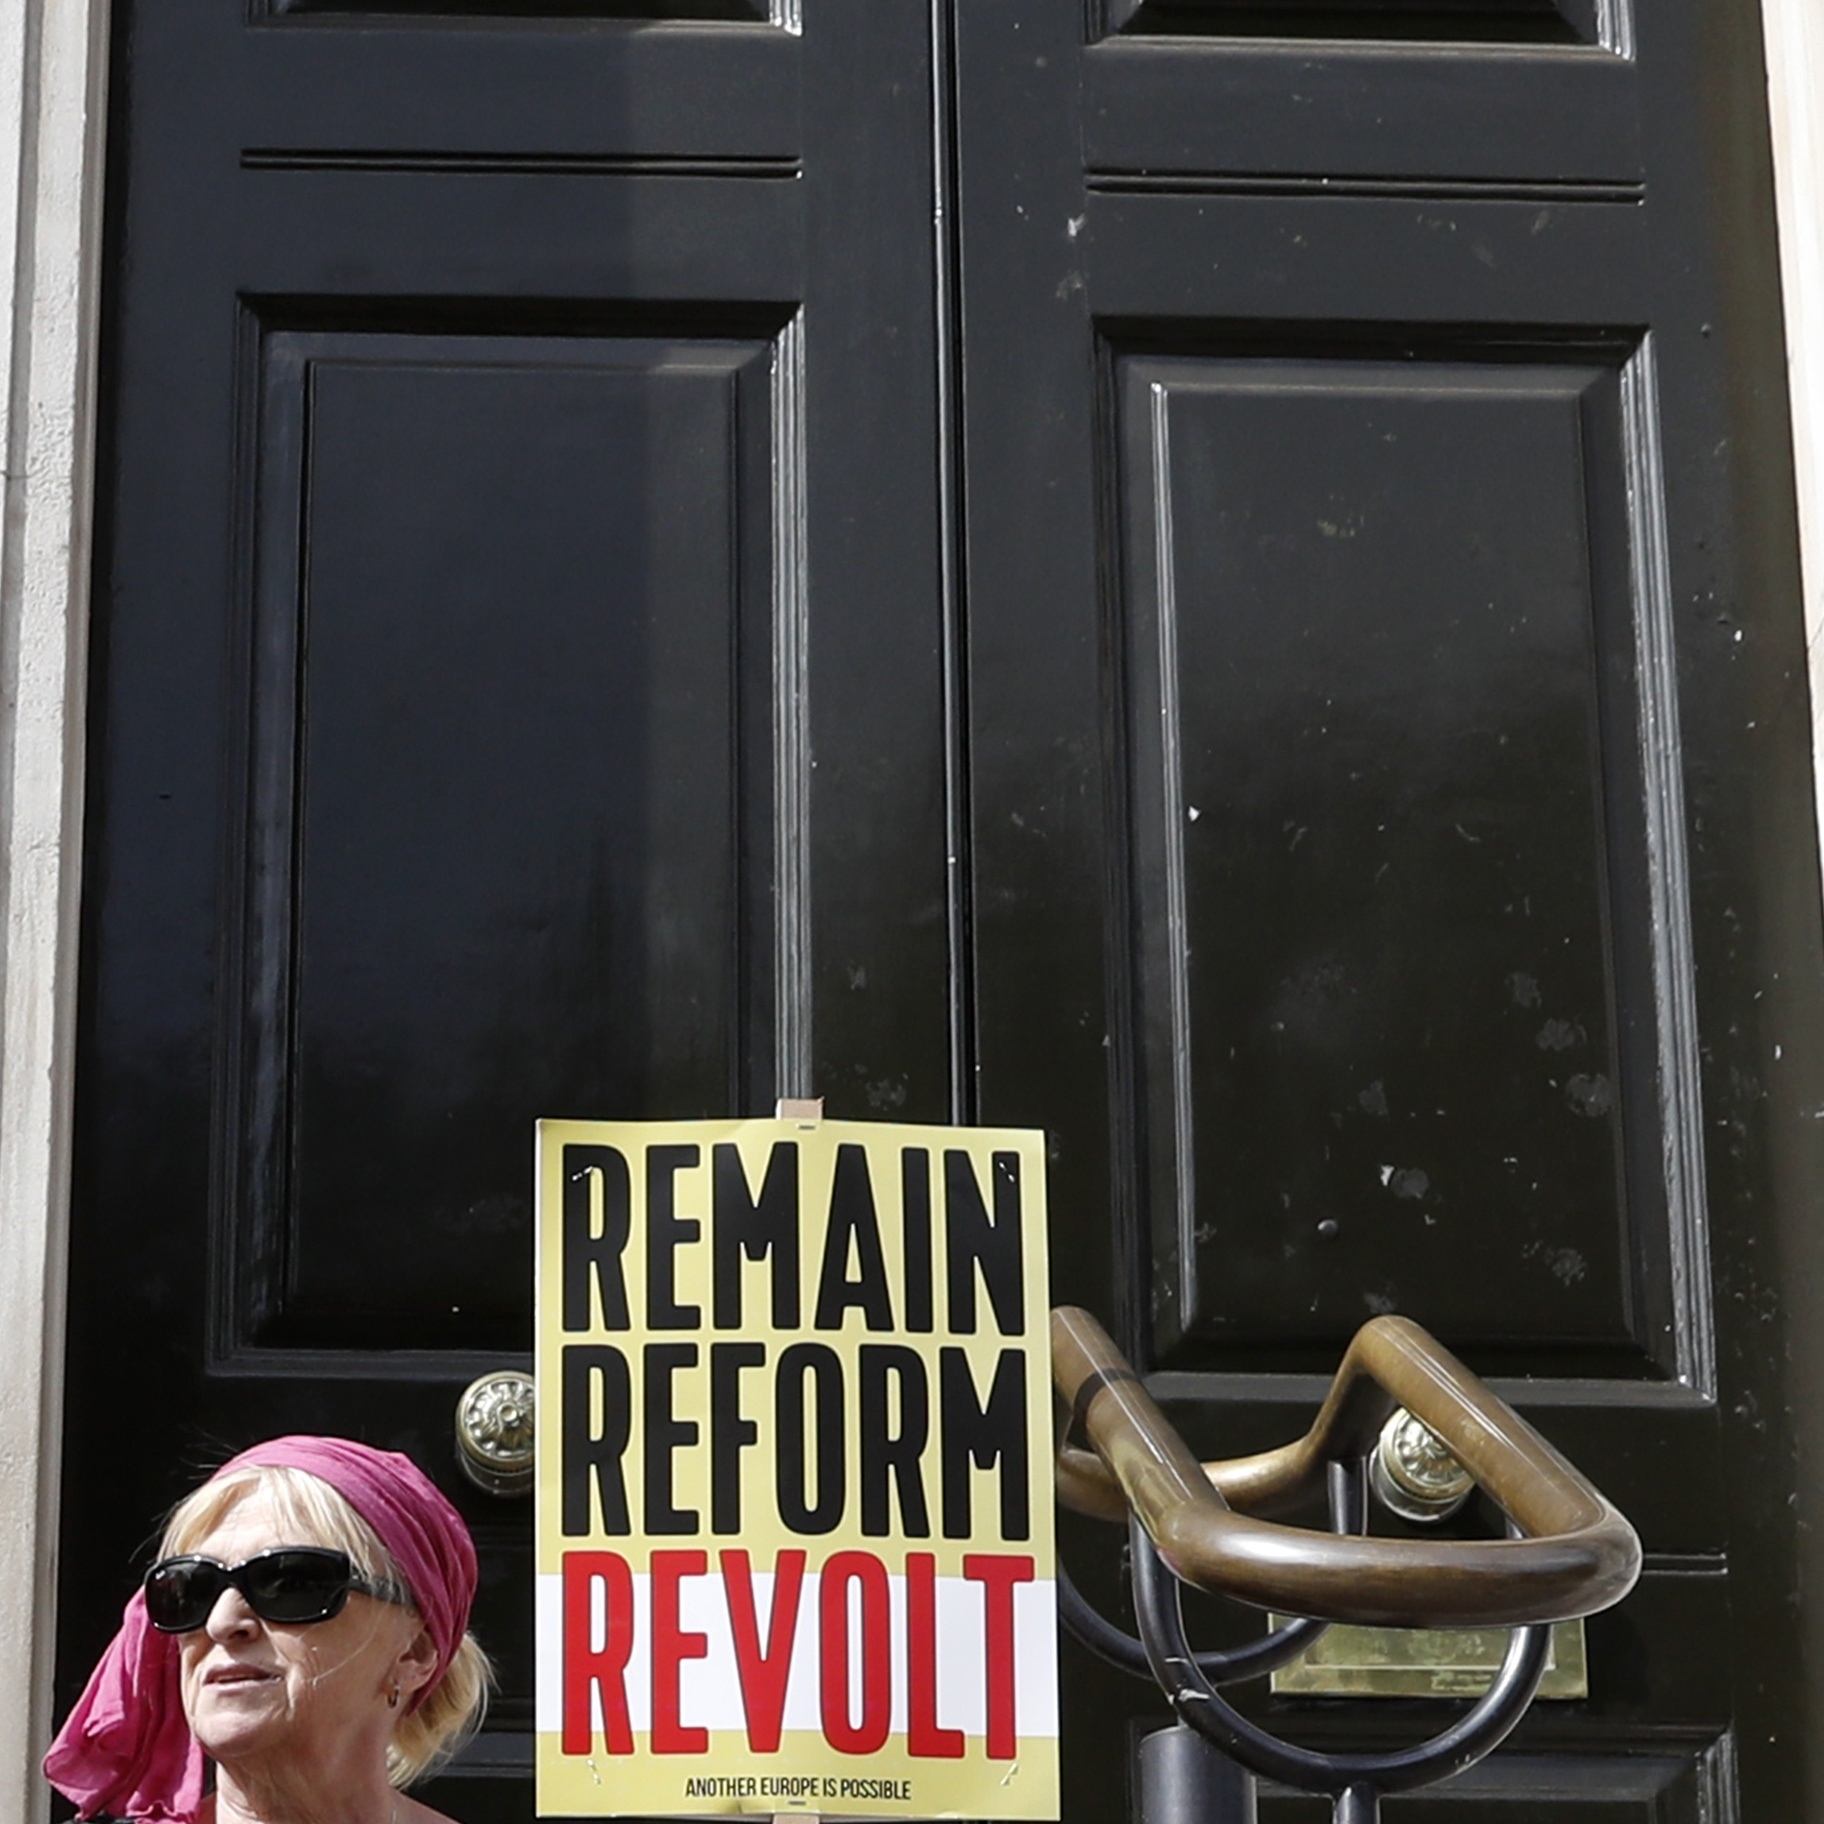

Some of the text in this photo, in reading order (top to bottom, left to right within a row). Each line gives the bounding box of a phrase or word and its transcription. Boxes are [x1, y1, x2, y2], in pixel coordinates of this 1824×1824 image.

[562, 1141, 1025, 1336] REMAIN
[561, 1342, 1030, 1541] REFORM
[561, 1549, 1035, 1760] REVOLT
[685, 1777, 912, 1800] ANOTHER EUROPE IS POSSIBLE
